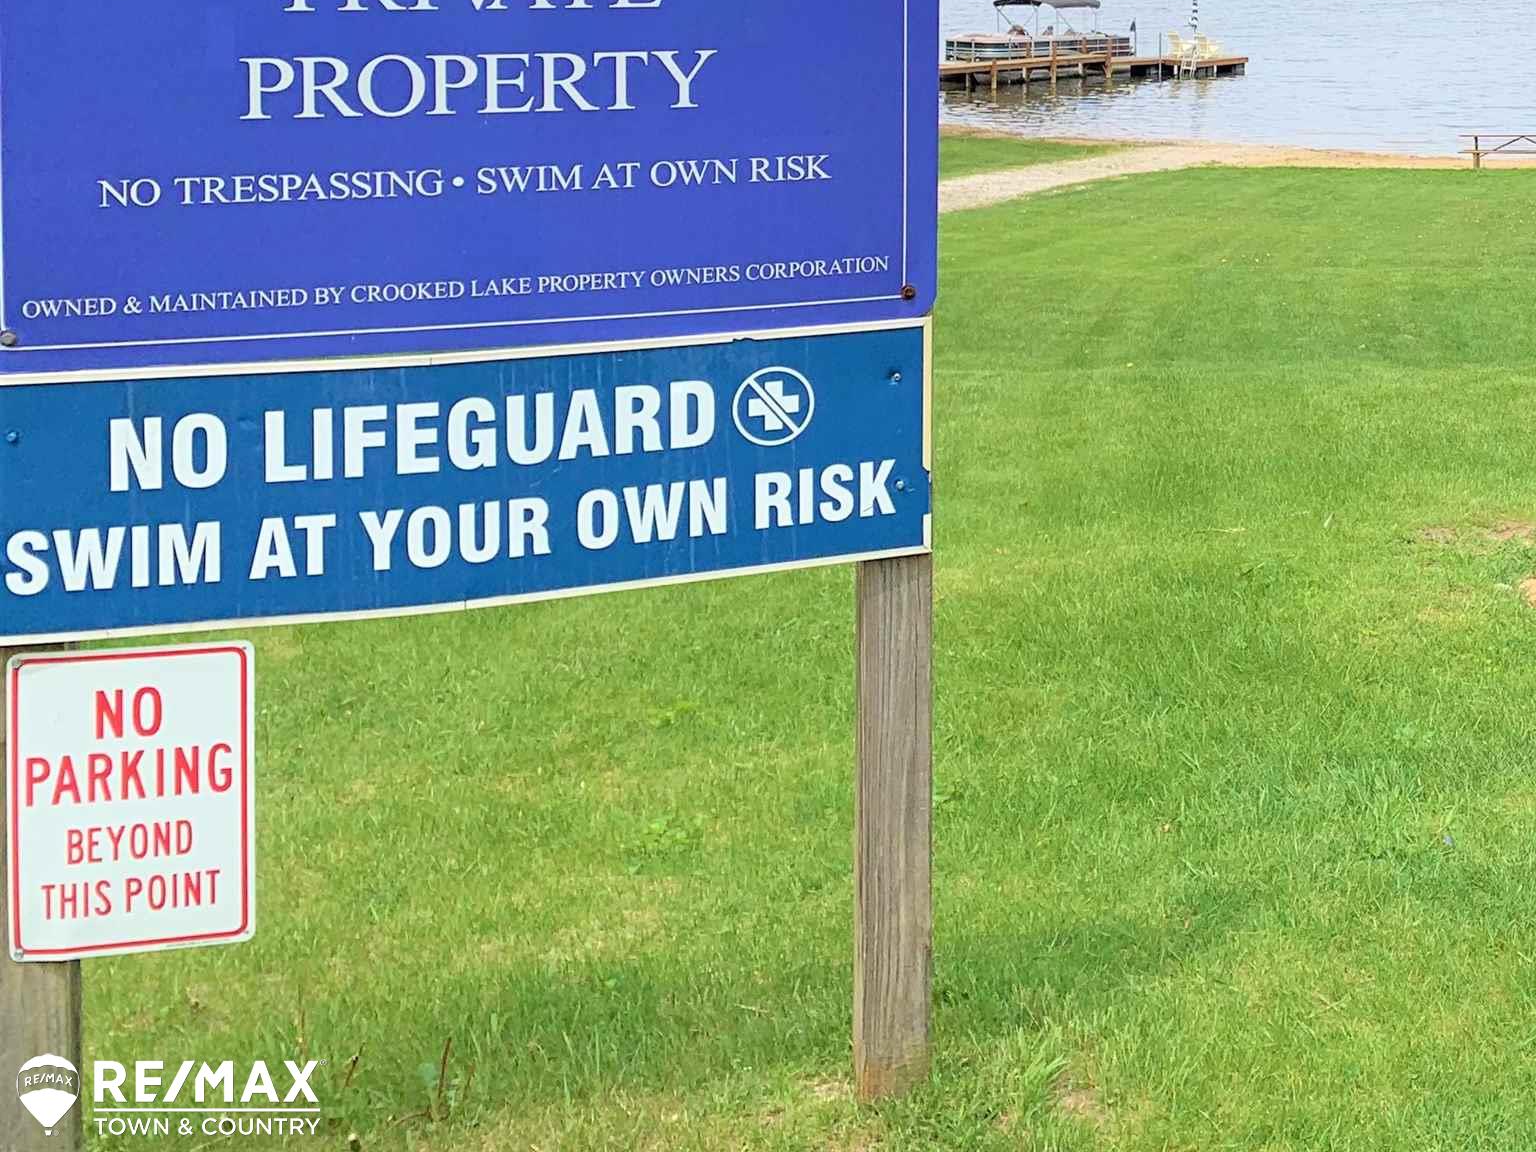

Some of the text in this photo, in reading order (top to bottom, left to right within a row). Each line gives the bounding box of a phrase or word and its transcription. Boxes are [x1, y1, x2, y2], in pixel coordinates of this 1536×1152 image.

[240, 50, 717, 119] PROPERTY
[98, 155, 831, 207] NO TRESPASSING SWIM AT OWN RISK
[23, 256, 888, 318] OWNED & MAINTAINED BY CROOKED LAKE PROPERTY OWNERS CORPORATION
[111, 380, 715, 491] NO LIFEGUARD
[6, 460, 895, 595] SWIM AT YOUR OWN RISK
[96, 686, 162, 740] NO
[26, 743, 232, 806] PARKING
[67, 820, 192, 864] BEYOND
[43, 869, 221, 918] THIS POINT
